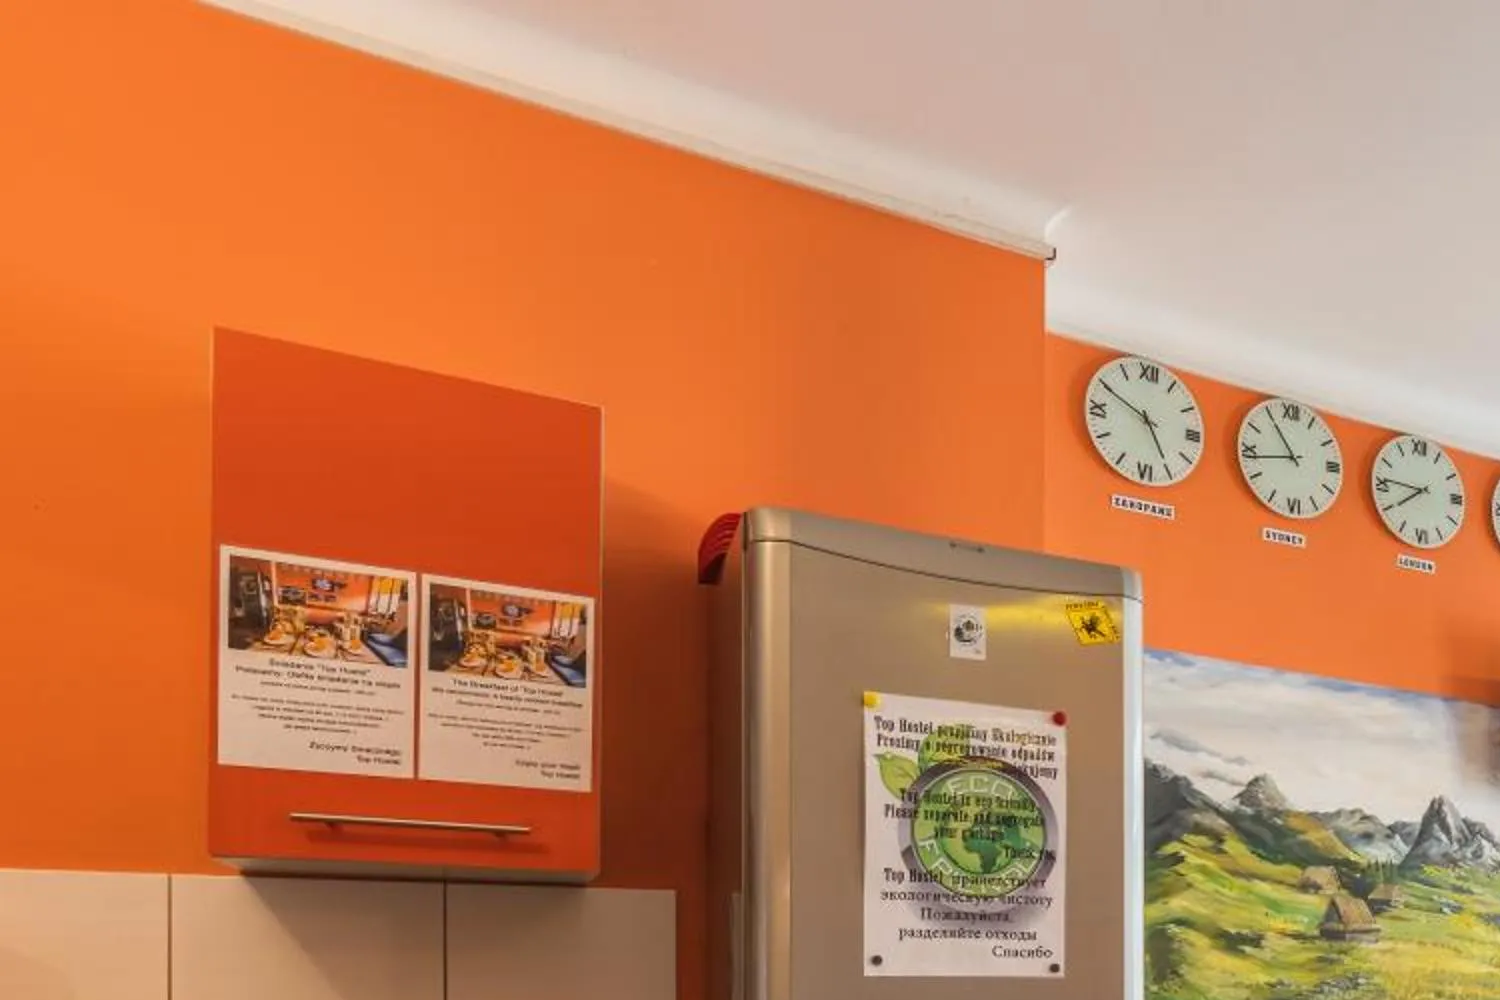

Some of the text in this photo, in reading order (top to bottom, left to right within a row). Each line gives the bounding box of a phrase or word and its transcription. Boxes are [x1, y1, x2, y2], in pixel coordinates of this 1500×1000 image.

[1140, 362, 1158, 384] XII
[1089, 399, 1107, 419] IX
[1282, 402, 1300, 421] XII
[1185, 429, 1200, 443] III
[1137, 461, 1153, 482] VI
[1287, 497, 1300, 515] VI
[873, 715, 895, 733] Top
[899, 719, 934, 736] Hostel
[877, 733, 920, 752] Prosimy
[883, 867, 905, 884] Top
[898, 927, 1037, 942] разделяйте отходы
[991, 945, 1053, 959] Спасибо
